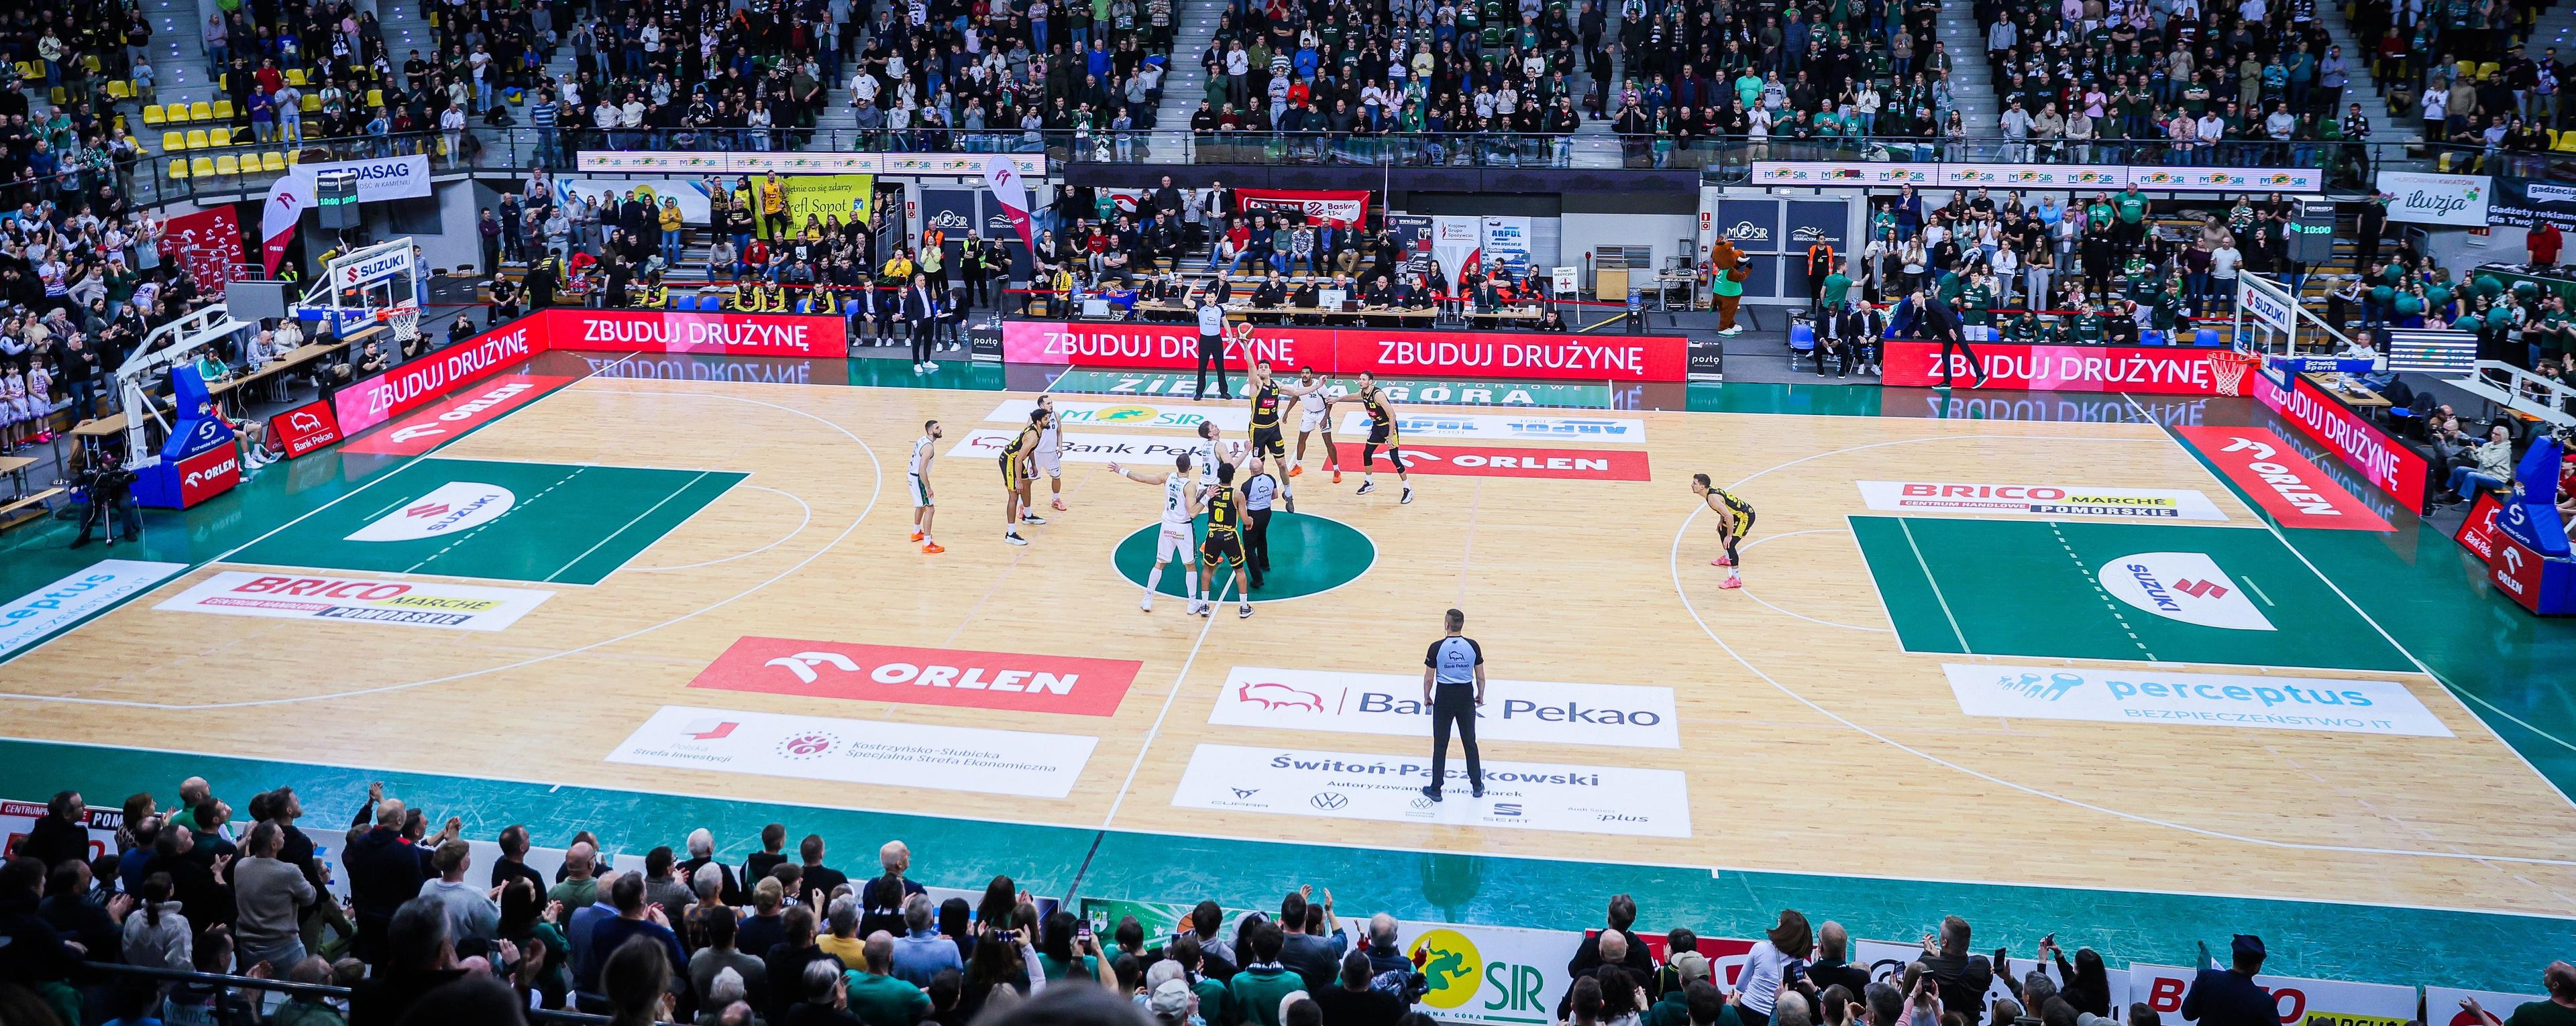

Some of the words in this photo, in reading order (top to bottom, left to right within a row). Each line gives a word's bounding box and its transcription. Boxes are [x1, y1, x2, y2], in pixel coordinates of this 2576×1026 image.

[348, 163, 409, 180] DASAG
[357, 181, 373, 190] KOŚĆ
[382, 180, 411, 188] KAMIENIU
[818, 184, 826, 193] się
[828, 182, 853, 192] zdarzy
[342, 194, 357, 205] 10:00
[789, 197, 809, 217] refl
[812, 199, 847, 215] Sopot
[2406, 190, 2469, 217] iluzja
[2488, 215, 2505, 223] dla
[2489, 205, 2533, 218] Gadżety
[2303, 226, 2331, 234] 10:00
[361, 254, 404, 278] SUZUKI
[2255, 296, 2285, 325] SUZUKI
[583, 319, 681, 343] ZBUDUJ
[690, 319, 808, 351] DRUŻYNĘ
[1042, 333, 1152, 357] ZBUDUJ
[1377, 341, 1493, 366] ZBUDUJ
[1502, 340, 1644, 375] DRUŻYNĘ
[367, 367, 444, 415] ZBUDUJ
[448, 328, 529, 382] DRUŻYNĘ
[2060, 353, 2210, 388] DRUŻYNĘ
[438, 382, 535, 421] ORLEN
[1384, 384, 1535, 404] GÓRA
[1507, 423, 1627, 435] ARPOL
[293, 439, 312, 452] Bank
[313, 432, 334, 447] Pekao
[2324, 410, 2400, 491] DRUŻYNĘ
[203, 457, 235, 481] ORLEN
[1452, 454, 1609, 472] ORLEN
[1902, 483, 2065, 500] BRICO
[2249, 463, 2343, 516] ORLEN
[426, 493, 502, 533] SUZUKI
[1214, 508, 1224, 522] 0
[2041, 506, 2172, 516] POMORSKIE
[230, 576, 413, 600] BRICO
[2126, 563, 2181, 612] SUZUKI
[2498, 570, 2522, 595] ORLEN
[203, 597, 260, 608] CENTRUM
[259, 600, 326, 611] HANDLOWE
[329, 606, 467, 626] POMORSKIE
[871, 661, 1079, 696] ORLEN
[2106, 677, 2373, 708] perceptus
[1503, 699, 1660, 726] Pekao
[2124, 707, 2366, 728] BEZPIECZEŃSTWO
[2372, 720, 2393, 728] IT
[633, 747, 668, 758] Strefa
[671, 750, 733, 763] Inwestycji
[671, 742, 709, 752] Polska
[852, 741, 1000, 760] Kostrzyńsko-Słubicka
[845, 749, 914, 762] Specjalna
[916, 754, 960, 766] Strefa
[963, 758, 1057, 773] Ekonomiczna
[1326, 780, 1425, 793] Autoryzowany
[5, 805, 44, 816] CENTRUM
[1211, 799, 1269, 807] CUPRA
[1454, 1012, 1481, 1020] GÓRA
